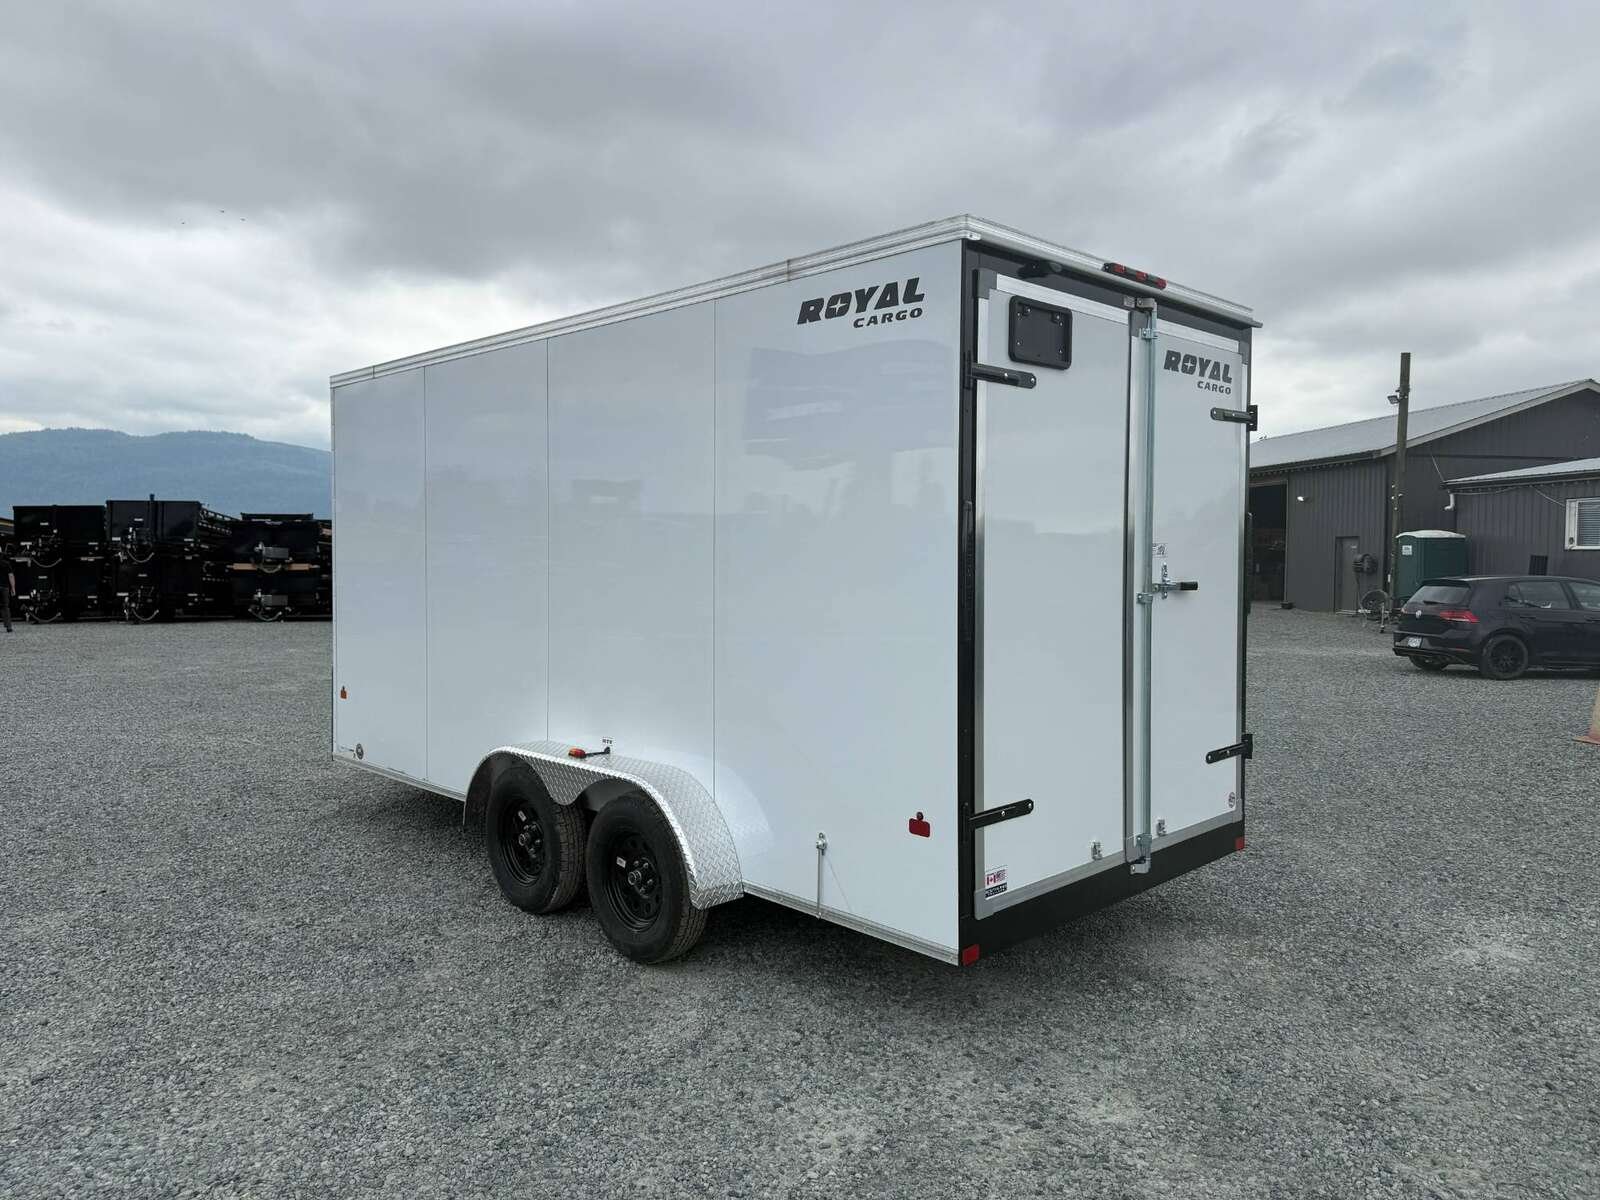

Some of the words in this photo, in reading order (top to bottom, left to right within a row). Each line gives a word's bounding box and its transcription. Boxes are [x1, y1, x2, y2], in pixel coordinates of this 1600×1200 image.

[797, 277, 925, 325] ROYAL
[853, 307, 923, 328] CARGO
[1163, 350, 1232, 384] ROYAL
[1197, 381, 1232, 395] CARGO
